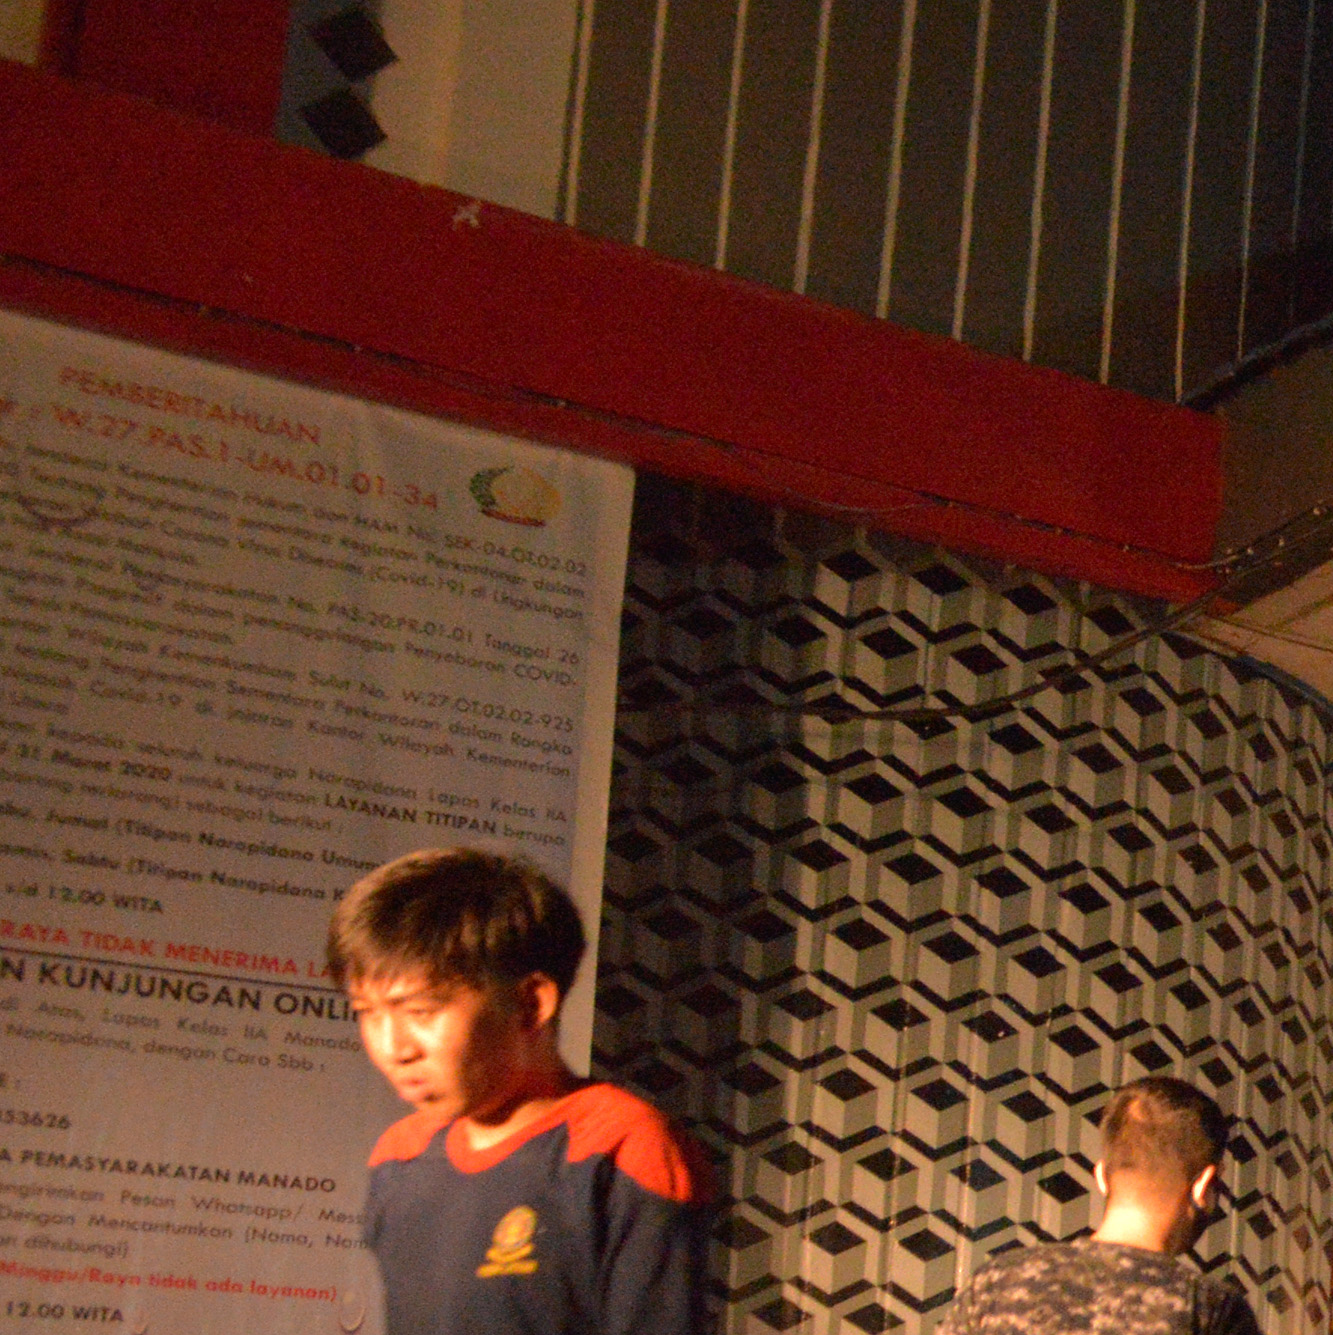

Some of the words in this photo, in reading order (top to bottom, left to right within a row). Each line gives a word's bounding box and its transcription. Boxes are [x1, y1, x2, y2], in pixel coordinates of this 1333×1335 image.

[59, 364, 320, 447] PEMBERITAHUAN
[323, 792, 417, 823] LAYANAN
[424, 809, 496, 835] TITIPAN
[113, 891, 164, 915] WITA
[77, 929, 155, 957] TIDAK
[164, 940, 298, 975] MENERIMA
[37, 960, 262, 1012] KUNJUNGAN
[175, 1016, 228, 1038] Kelas
[276, 1053, 314, 1072] Sbb
[20, 1149, 231, 1183] PEMASYARAKATAN
[236, 1169, 337, 1193] MANADO
[120, 1188, 175, 1209] Pesan
[87, 1214, 233, 1241] Mencantumkan
[148, 1270, 197, 1289] tidak
[204, 1275, 244, 1293] ada
[249, 1278, 338, 1303] layanan)
[6, 1300, 65, 1320] 12.00
[71, 1304, 125, 1324] WITA
